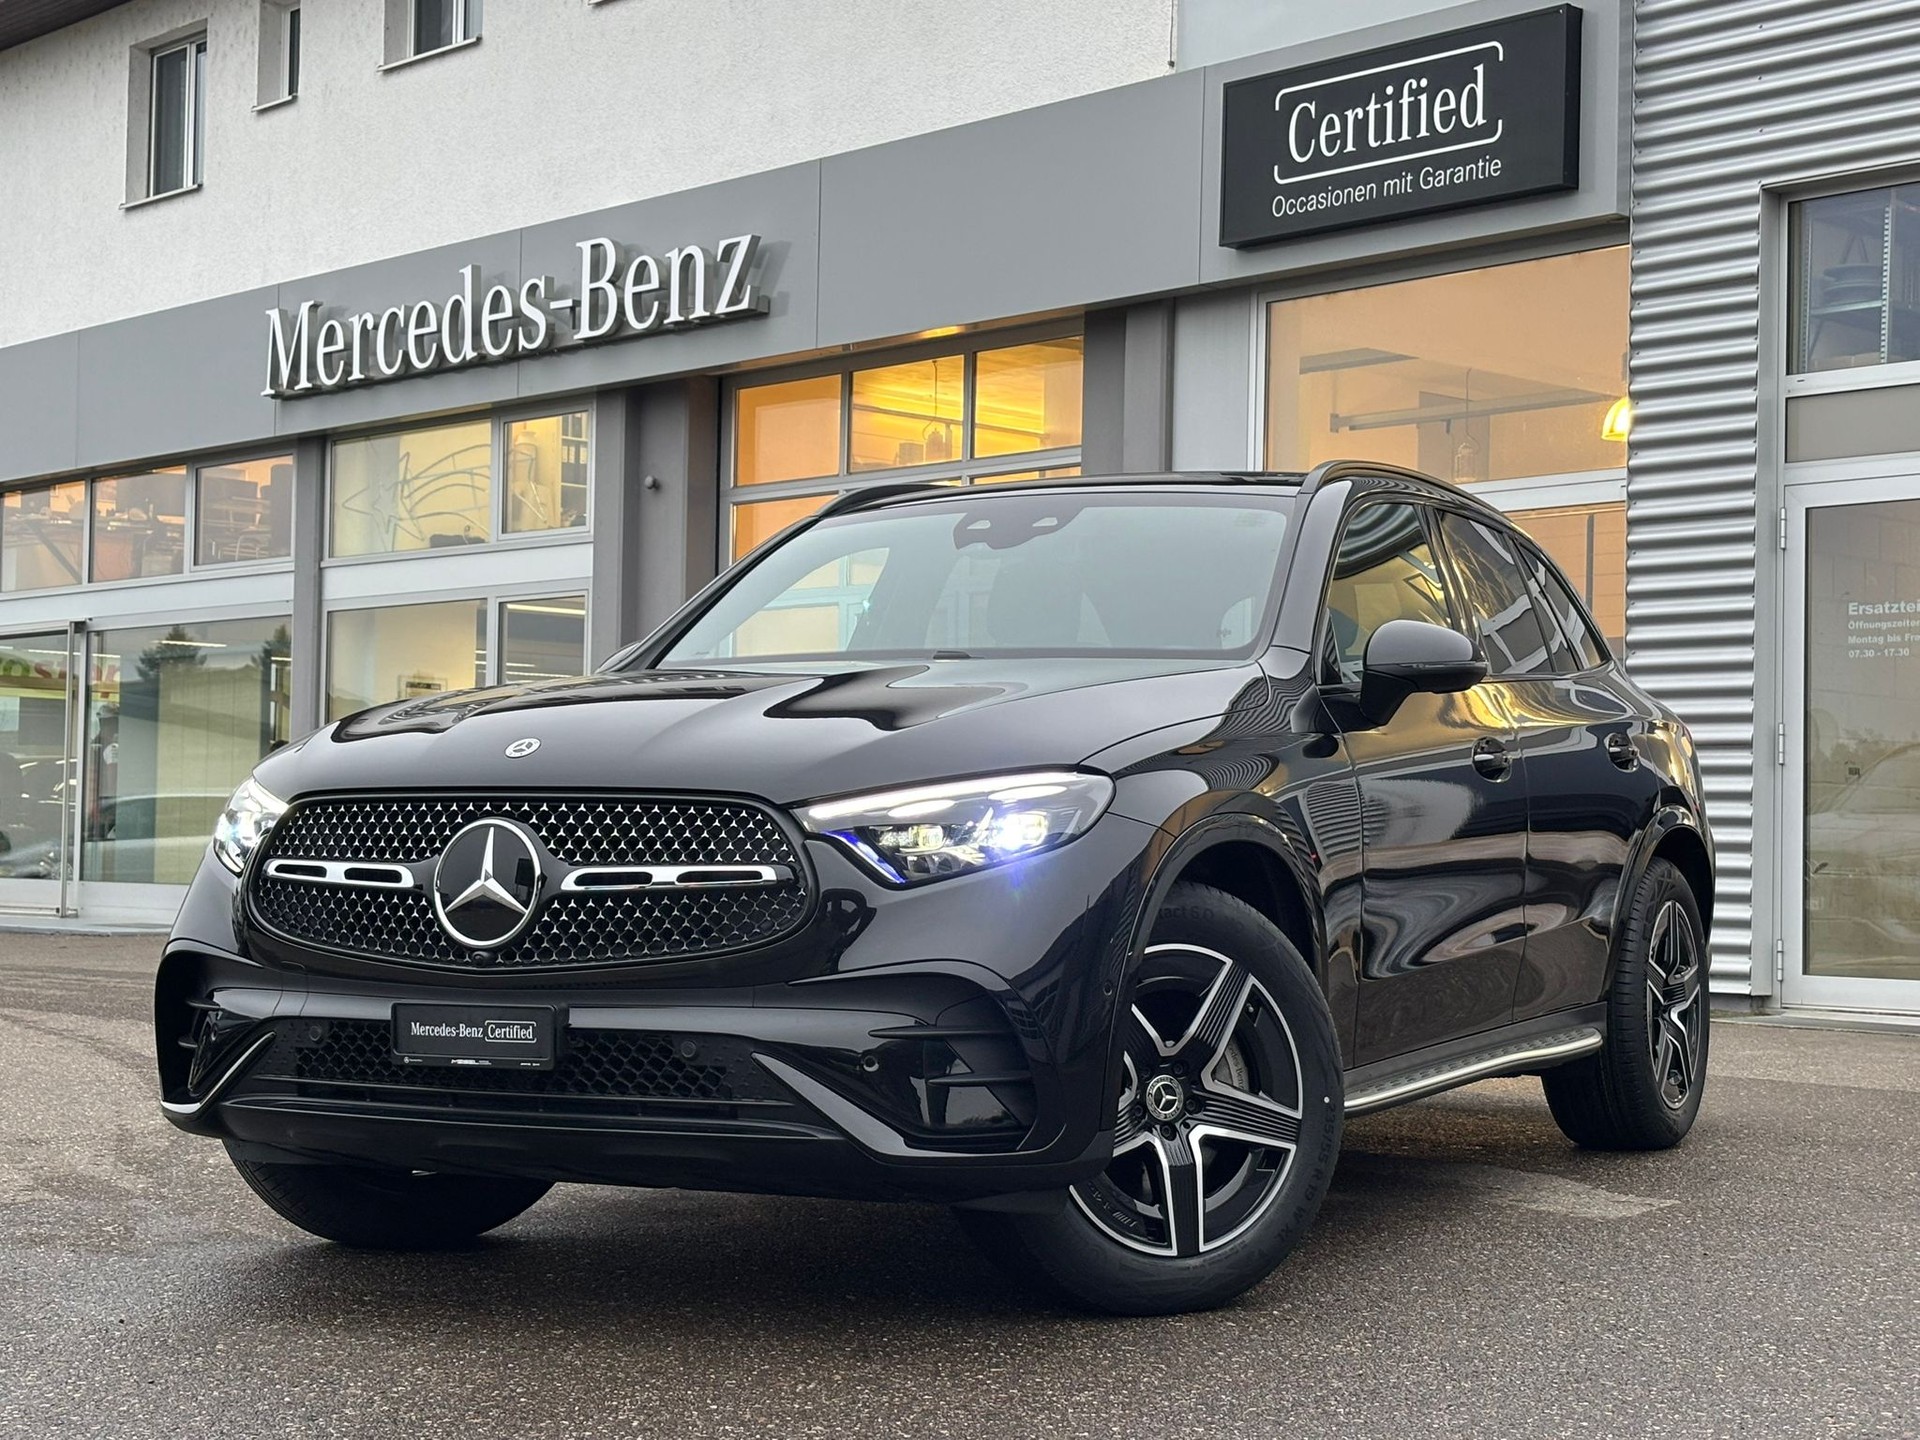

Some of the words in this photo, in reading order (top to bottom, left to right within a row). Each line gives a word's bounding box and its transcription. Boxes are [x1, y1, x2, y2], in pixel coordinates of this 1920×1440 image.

[1288, 62, 1487, 163] Certified
[1272, 181, 1377, 218] Occasionen
[1383, 171, 1413, 197] mit
[1419, 155, 1502, 191] Garantie
[260, 233, 764, 398] Mercedes-Benz
[1848, 635, 1885, 645] Montag
[1887, 633, 1901, 643] bis
[1848, 649, 1875, 659] 07.30
[1884, 647, 1910, 657] 17.30
[410, 1022, 484, 1038] Mercedes-Benz
[488, 1024, 533, 1040] Certified
